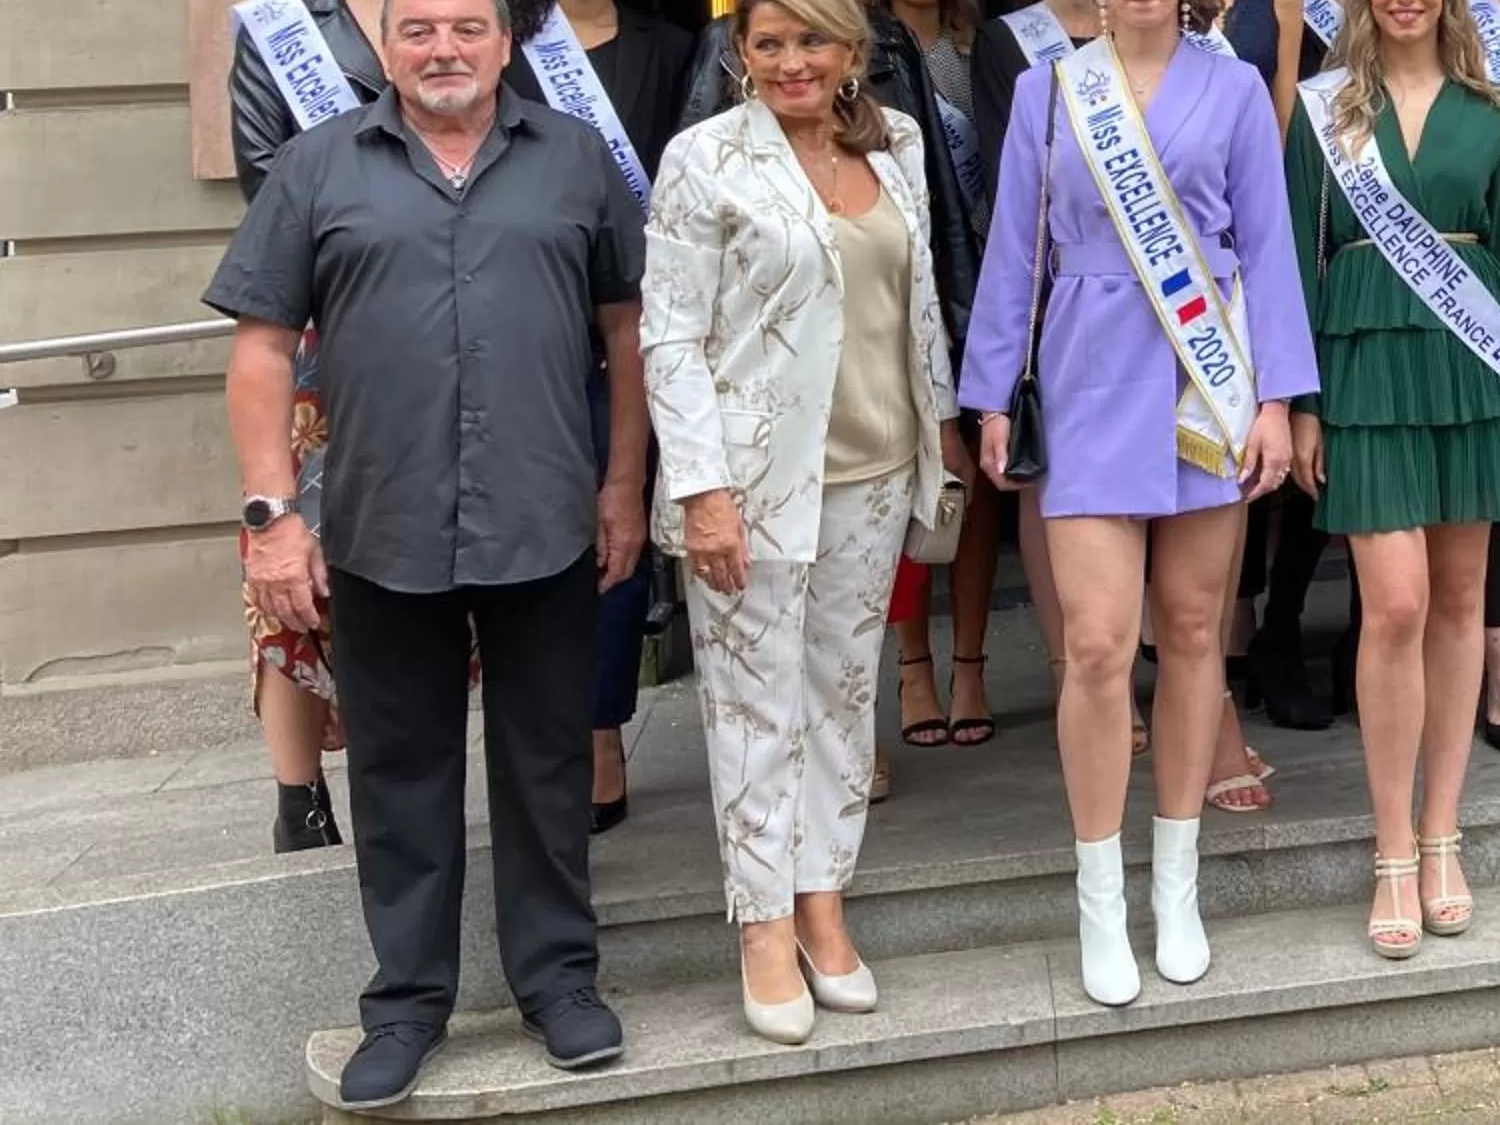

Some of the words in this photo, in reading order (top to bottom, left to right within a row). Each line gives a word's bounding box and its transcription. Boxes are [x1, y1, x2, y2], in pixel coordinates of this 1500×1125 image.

[1086, 104, 1122, 152] Miss
[1103, 147, 1186, 267] EXCELLENCE
[1385, 202, 1469, 294] DAUPHINE
[1340, 167, 1432, 287] EXCELLENCE
[1428, 286, 1493, 355] FRANCE
[1188, 326, 1237, 387] 2020
